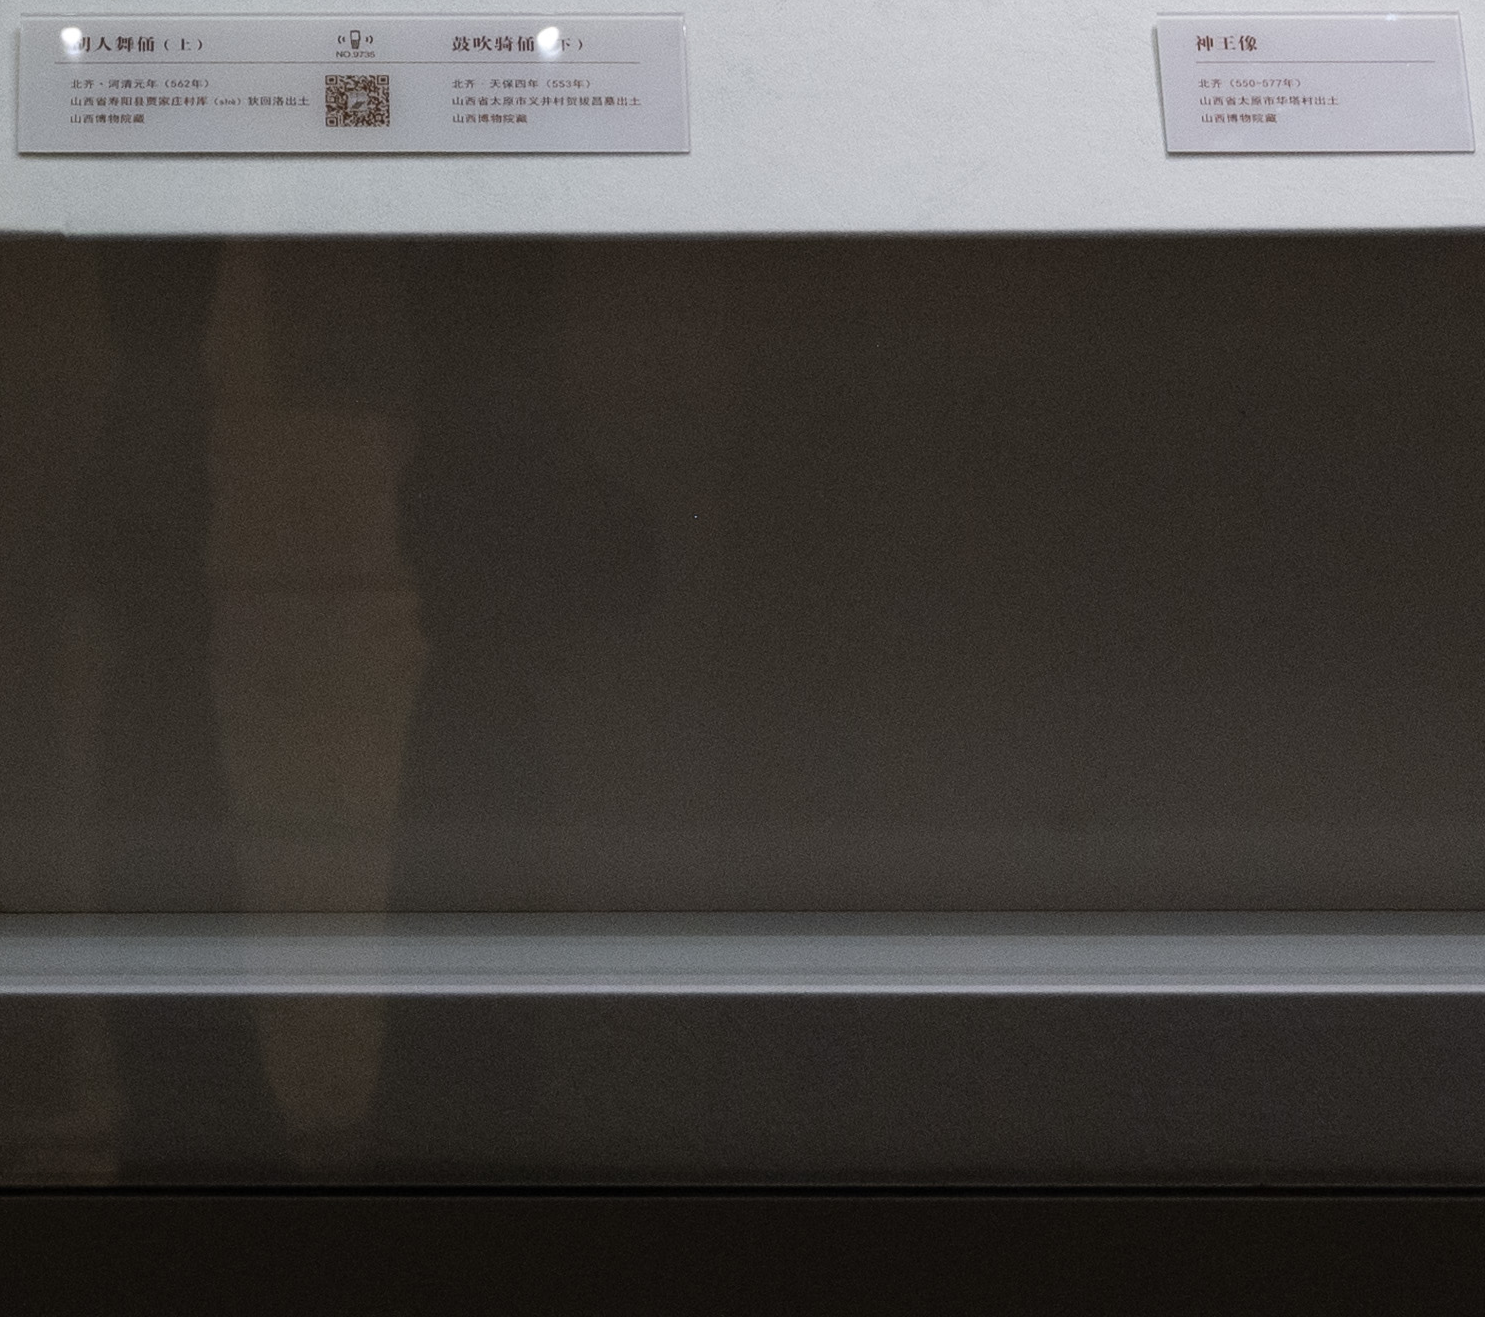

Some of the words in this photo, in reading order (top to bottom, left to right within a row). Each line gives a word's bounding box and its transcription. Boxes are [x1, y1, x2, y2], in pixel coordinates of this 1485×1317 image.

[451, 34, 584, 53] 鼓吹骑俑下）
[1195, 34, 1259, 53] 神王像
[70, 113, 146, 124] 山西博物院藏
[452, 113, 529, 124] 山西博物院藏
[1200, 112, 1279, 124] 山西博物院藏
